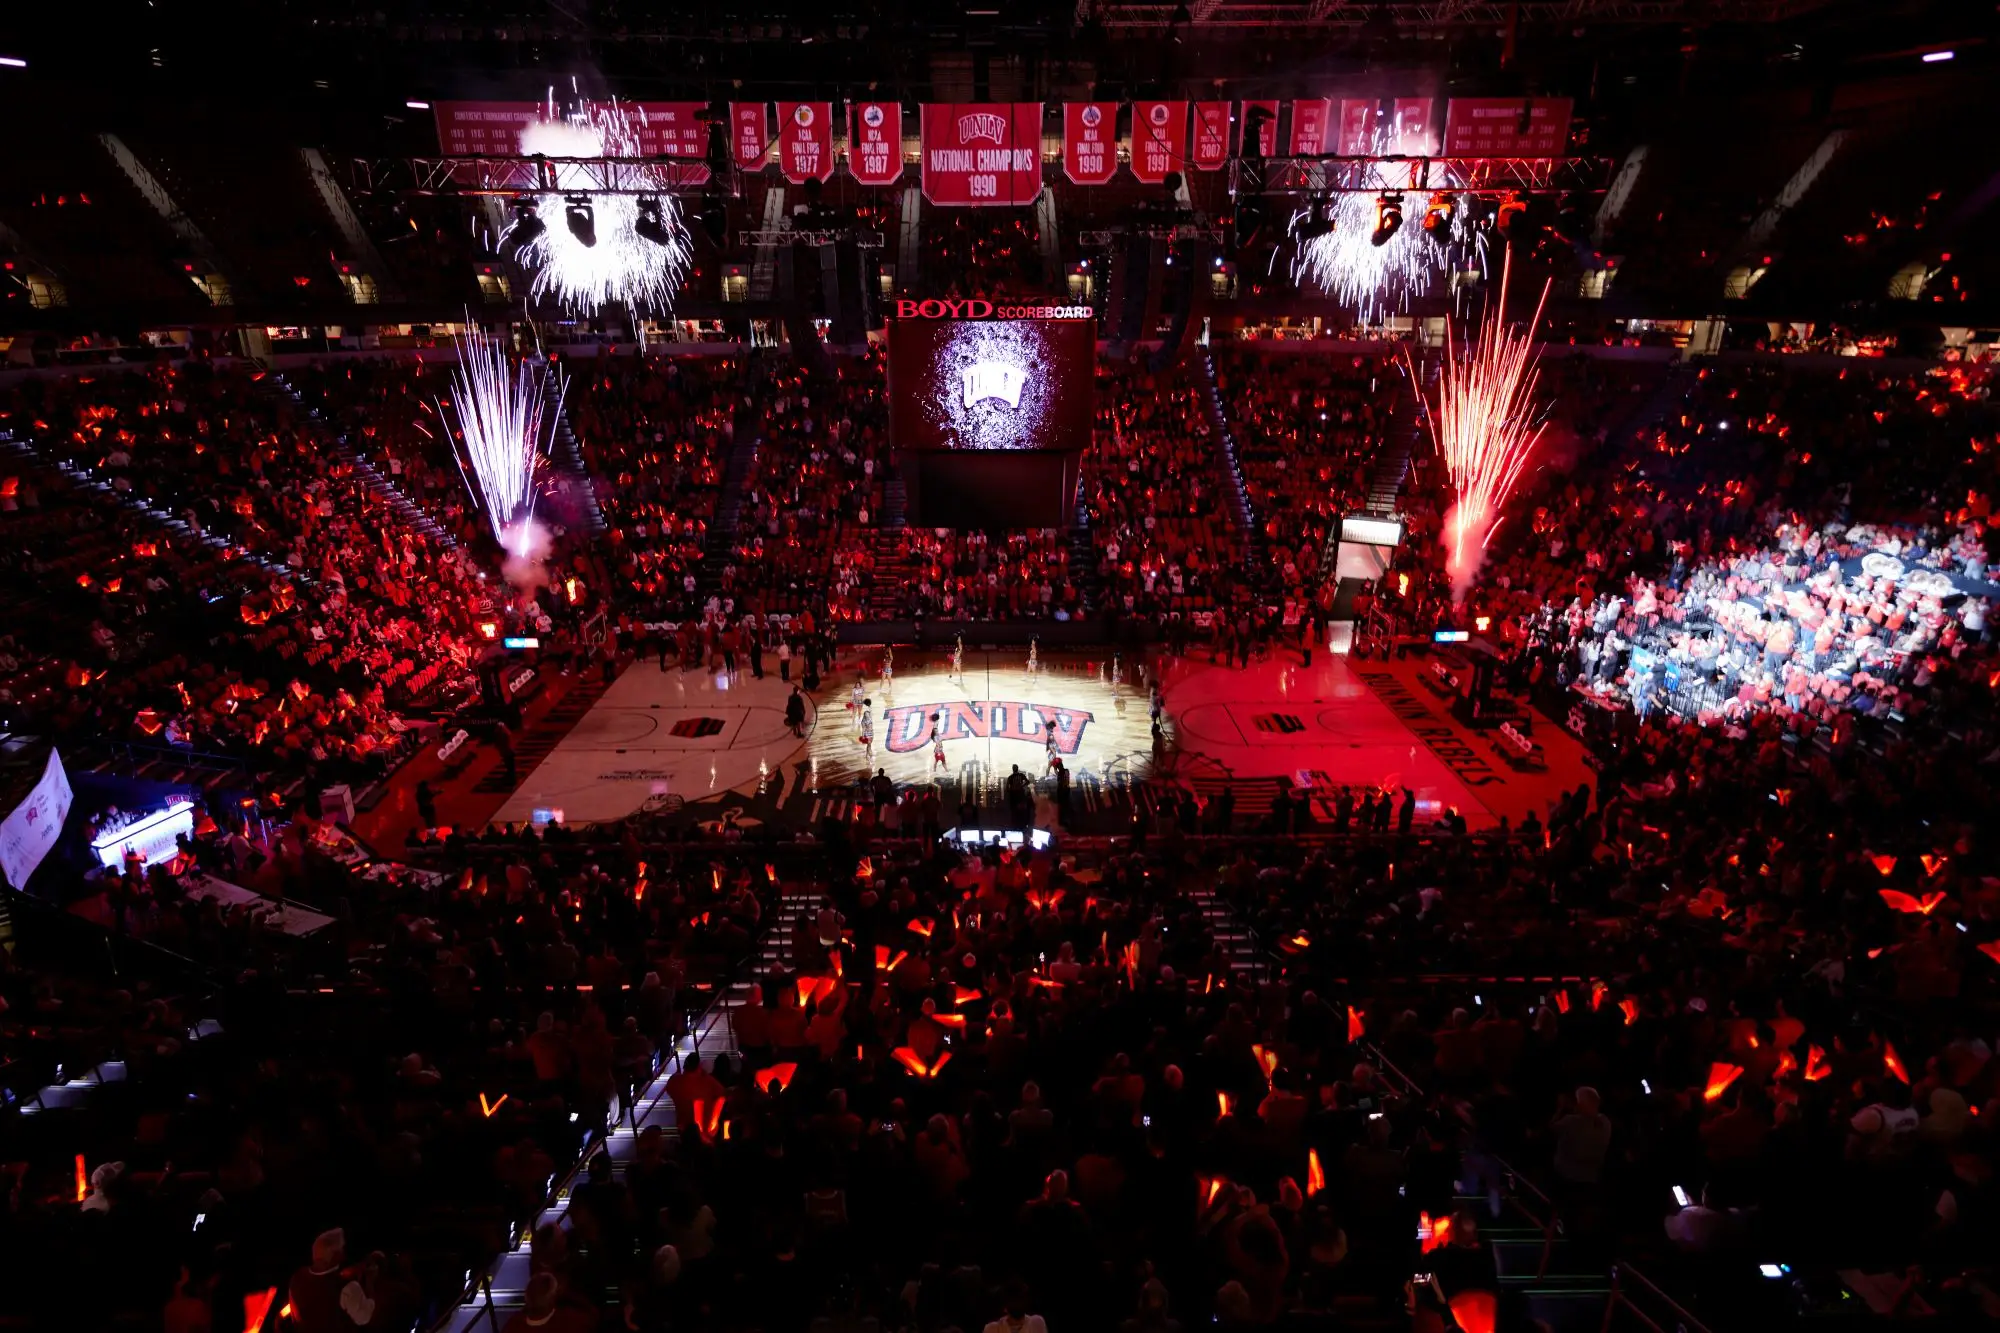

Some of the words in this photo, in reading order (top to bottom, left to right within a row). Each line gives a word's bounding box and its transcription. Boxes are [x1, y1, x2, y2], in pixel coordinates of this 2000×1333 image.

[798, 129, 812, 141] NCAA
[868, 129, 882, 141] NCAA
[958, 113, 1006, 145] UNLV
[1084, 129, 1098, 141] NCAA
[741, 144, 760, 159] 1989
[792, 142, 806, 154] FINAL
[806, 142, 820, 154] FOUR
[861, 142, 875, 154] FINAL
[876, 142, 889, 154] FOUR
[1077, 142, 1091, 154] FINAL
[1091, 142, 1105, 154] FOUR
[1145, 141, 1159, 153] FINAL
[1201, 143, 1221, 158] 2007
[794, 155, 818, 174] 1977
[864, 156, 888, 174] 1987
[931, 149, 975, 172] NATIONAL
[1078, 155, 1103, 174] 1990
[1147, 154, 1169, 173] 1991
[968, 174, 997, 197] 1990
[896, 300, 993, 319] BOYD
[997, 306, 1093, 319] SCOREBOARD
[883, 700, 1095, 754] UNLV
